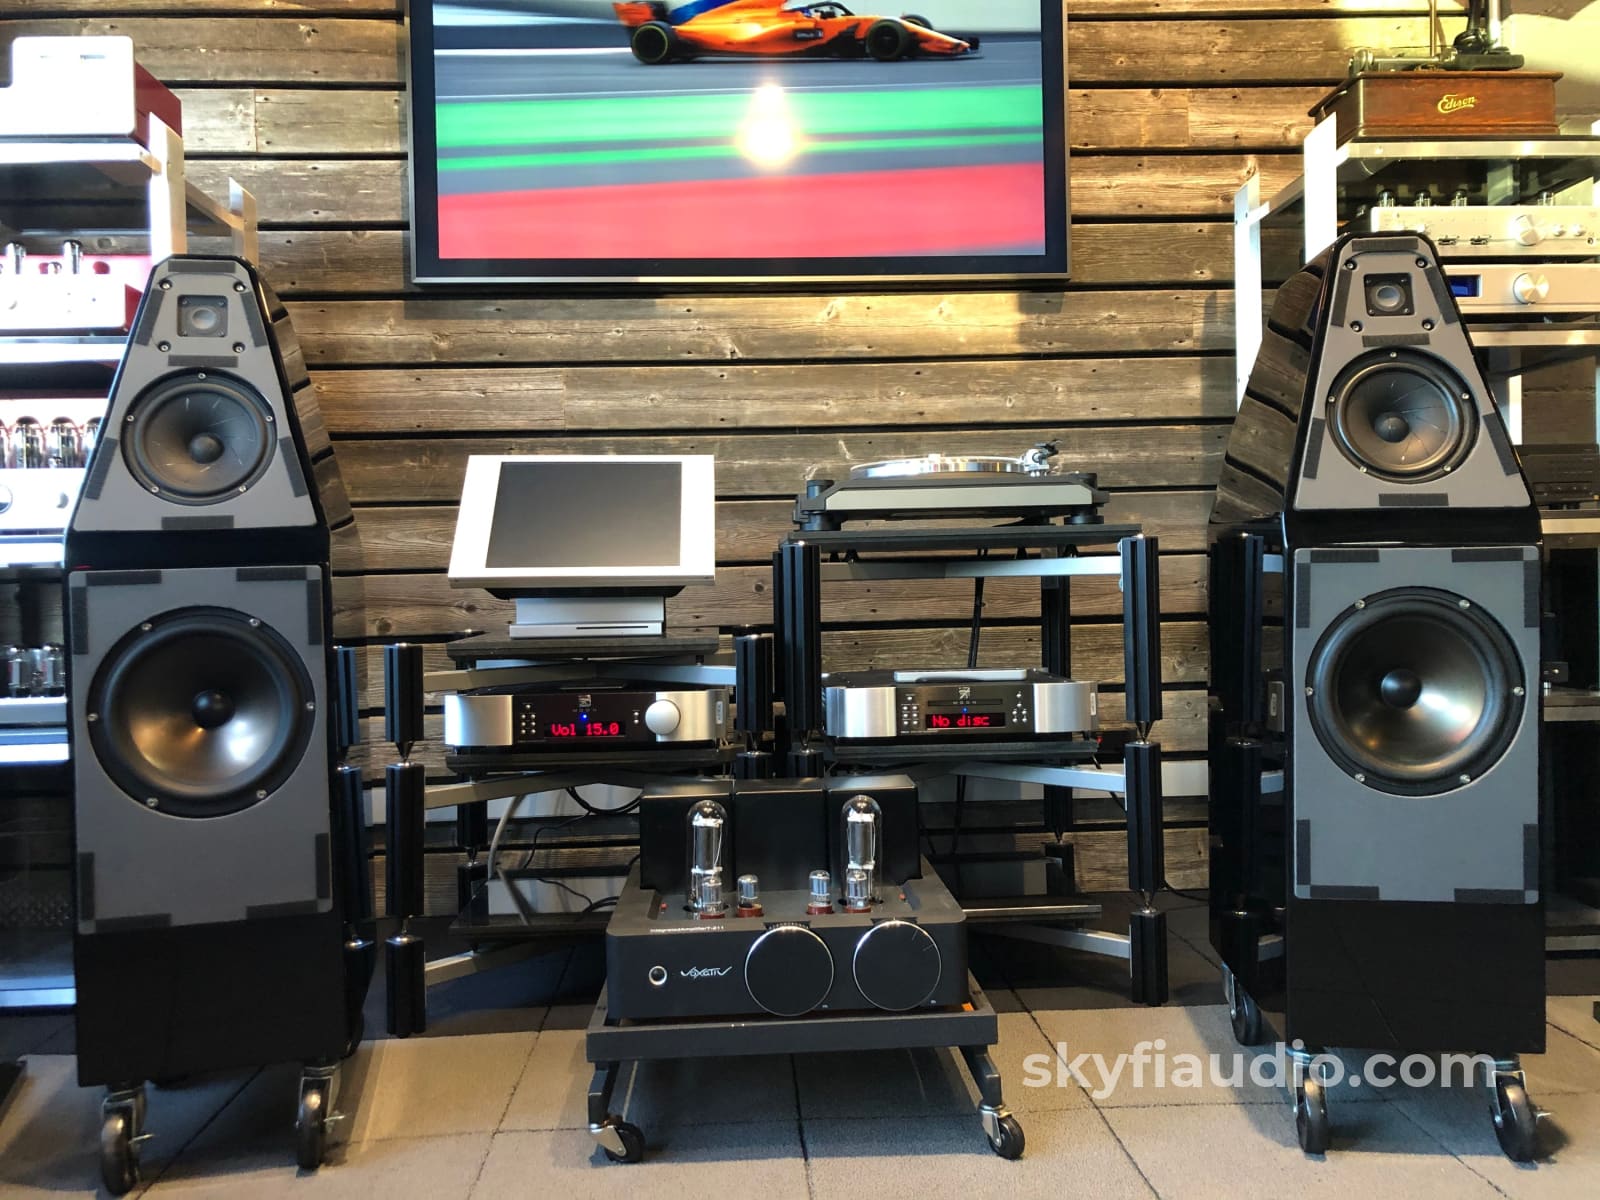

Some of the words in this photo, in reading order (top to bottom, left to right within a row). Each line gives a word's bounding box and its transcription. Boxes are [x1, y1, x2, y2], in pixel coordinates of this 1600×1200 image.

[1437, 94, 1477, 114] Edison
[932, 715, 950, 727] No
[957, 715, 990, 726] disc
[551, 723, 576, 736] Vol
[586, 722, 620, 736] 15.0
